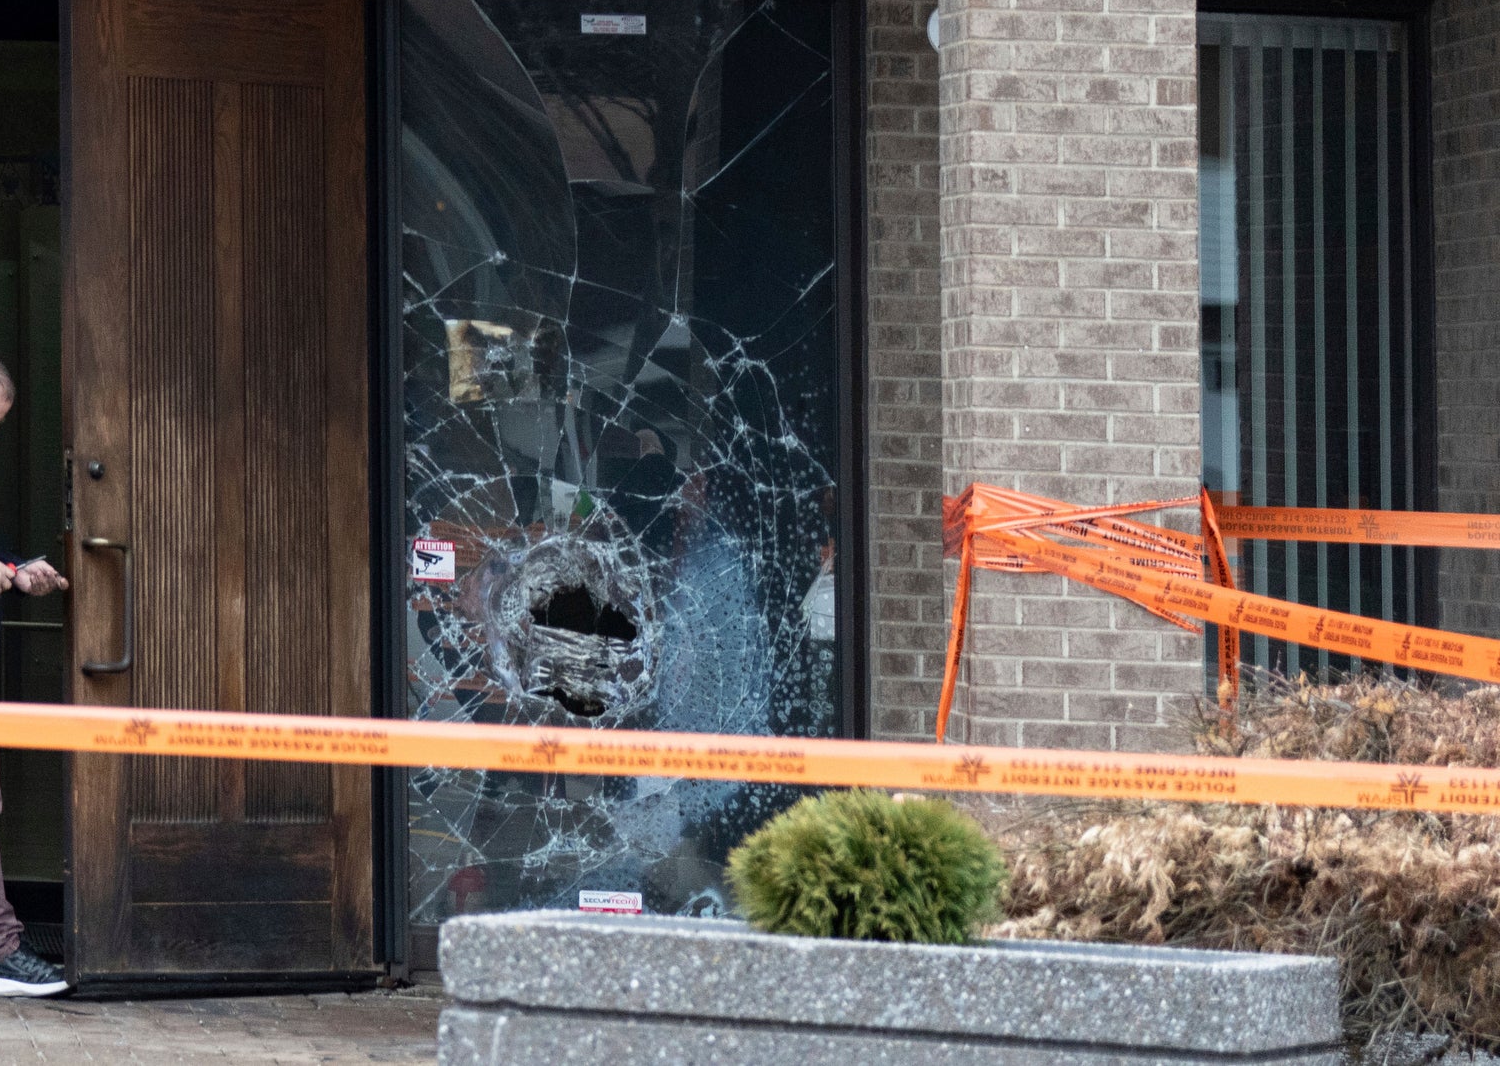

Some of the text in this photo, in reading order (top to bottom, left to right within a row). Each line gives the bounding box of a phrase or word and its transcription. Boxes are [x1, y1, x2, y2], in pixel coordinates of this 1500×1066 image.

[414, 540, 453, 551] ATTENTION
[1001, 772, 1236, 794] POLICE PASSAGE INTERDIT
